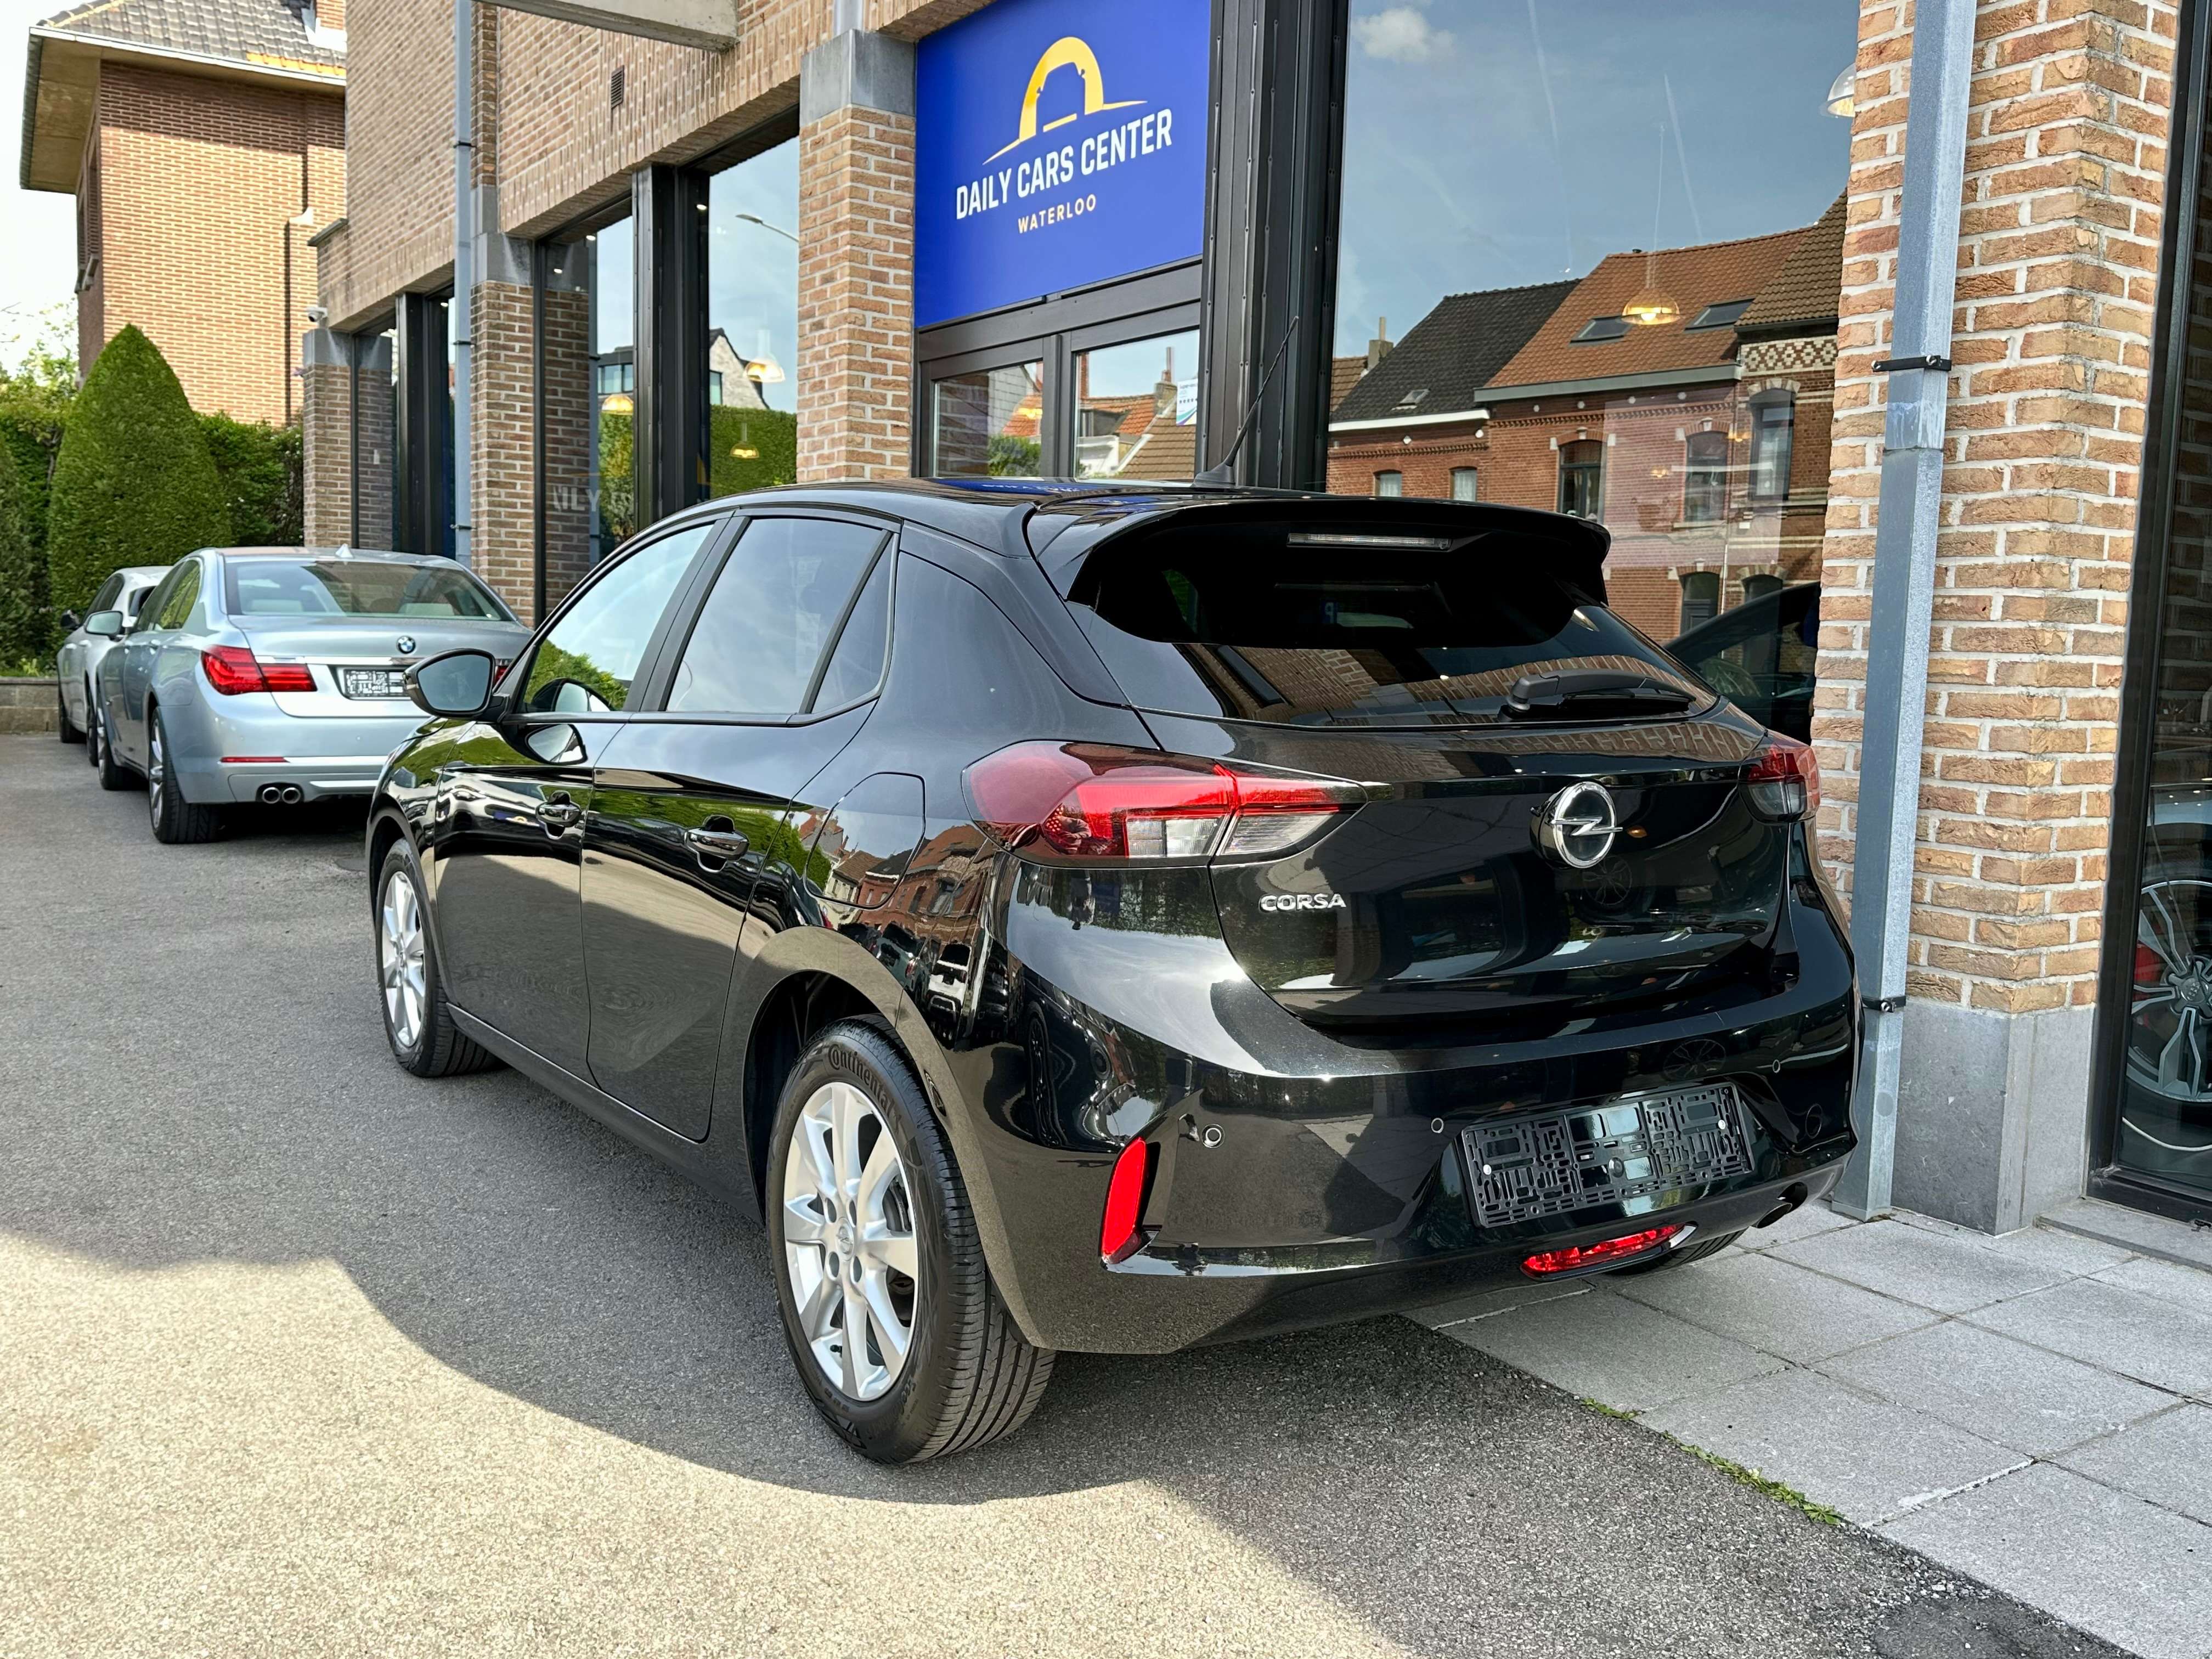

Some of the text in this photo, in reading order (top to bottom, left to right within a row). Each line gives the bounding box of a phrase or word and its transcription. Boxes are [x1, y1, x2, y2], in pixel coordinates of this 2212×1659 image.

[956, 109, 1172, 219] DAILY CARS CENTER
[1018, 194, 1097, 234] WATERLOO
[1260, 893, 1346, 911] CORSA
[828, 1043, 895, 1119] Continental
